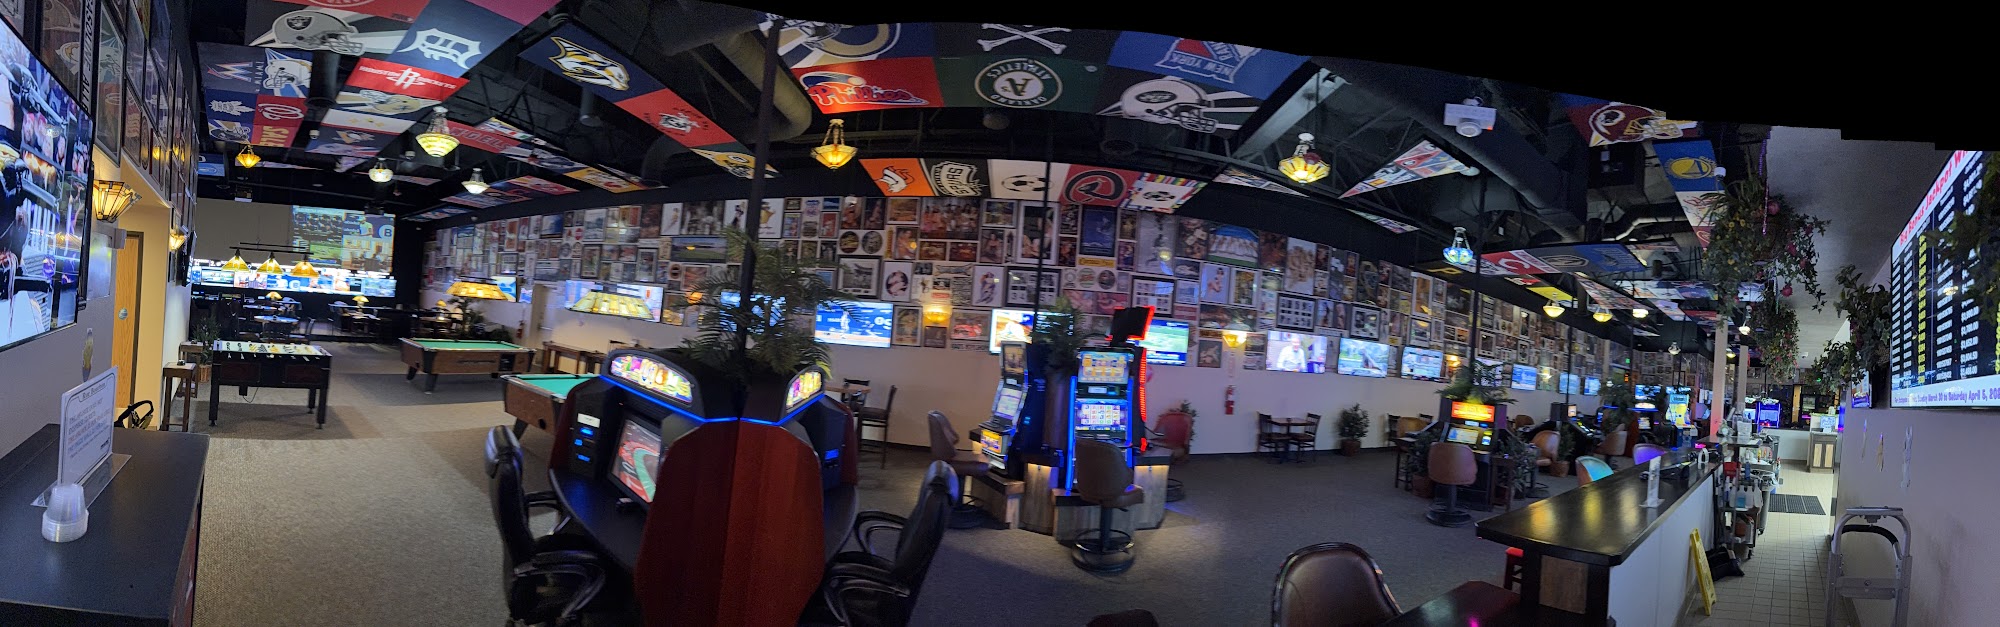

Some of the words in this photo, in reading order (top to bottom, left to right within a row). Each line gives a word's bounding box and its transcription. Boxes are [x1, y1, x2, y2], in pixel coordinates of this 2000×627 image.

[1209, 41, 1235, 60] RAN
[1171, 52, 1203, 68] YORK
[1203, 61, 1233, 76] NEW
[254, 61, 265, 85] MIAMI
[986, 62, 1052, 80] ATHLETICS
[807, 84, 914, 105] Phillies
[990, 94, 1047, 106] OAKLAND
[949, 167, 969, 196] SPURS
[1908, 205, 1925, 233] Bonus
[1925, 161, 1953, 211] Jackpot
[1954, 150, 1968, 168] Wi
[1948, 391, 1967, 404] Saturday
[1968, 390, 1980, 403] April
